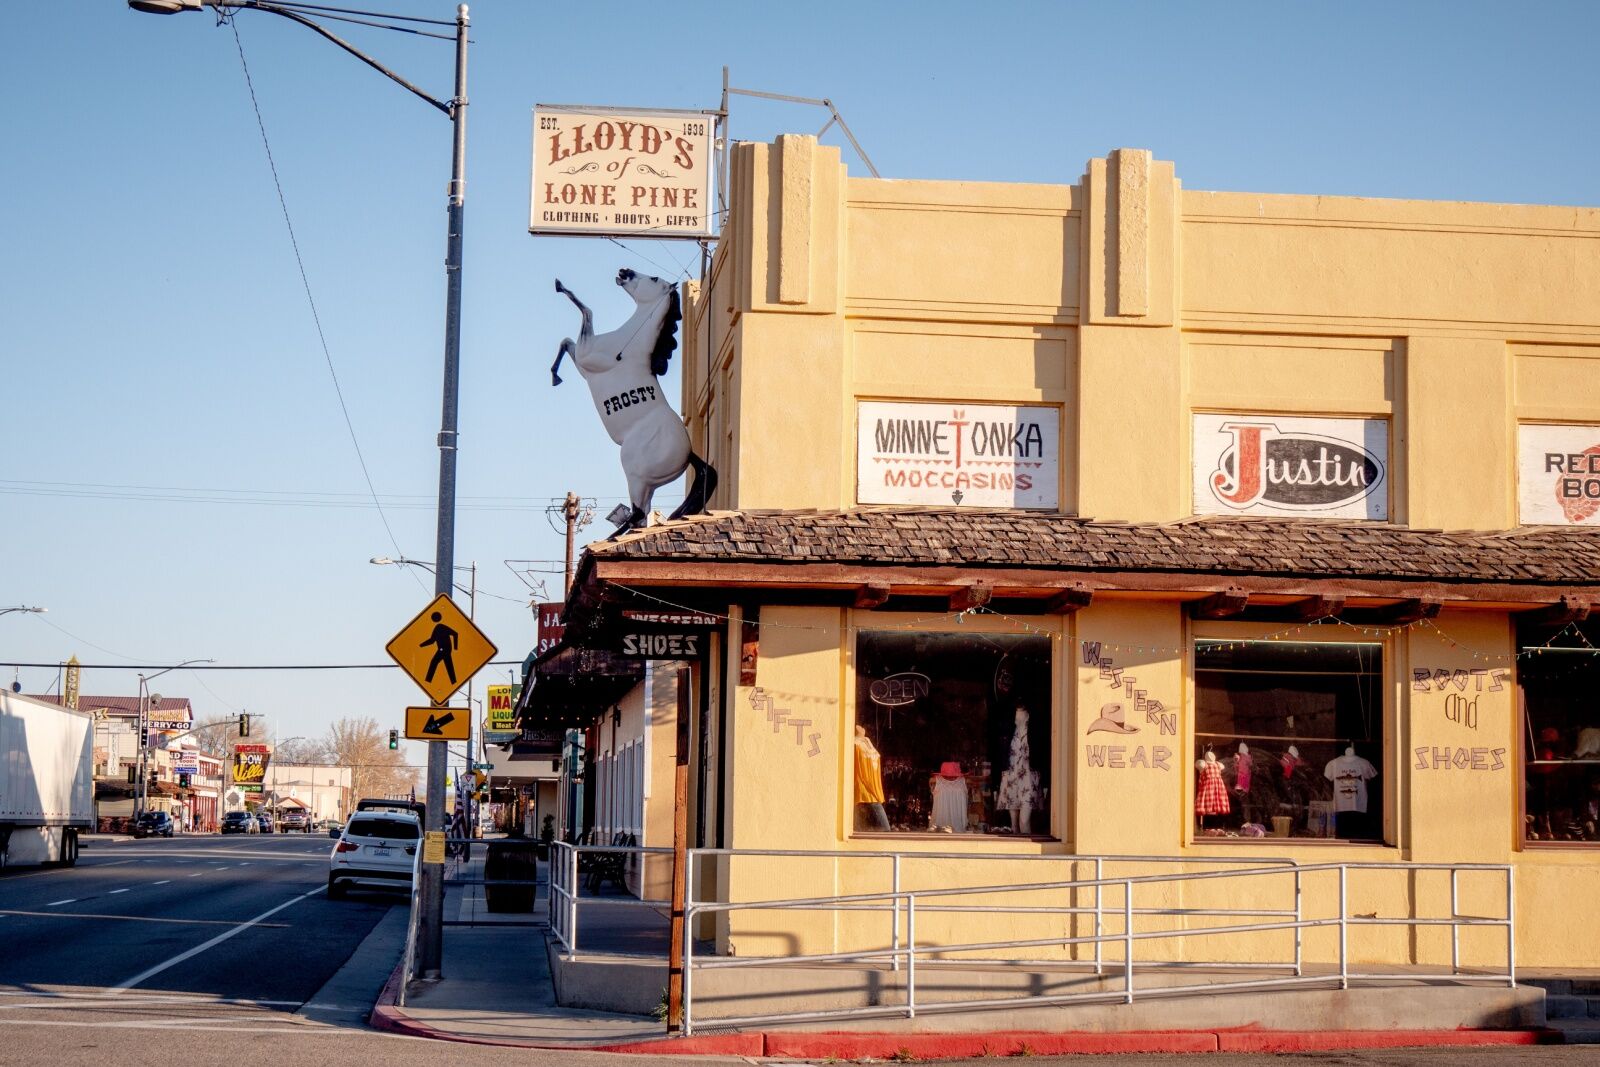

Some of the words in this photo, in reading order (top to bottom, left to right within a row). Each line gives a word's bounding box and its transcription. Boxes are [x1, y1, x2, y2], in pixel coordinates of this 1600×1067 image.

[540, 117, 560, 131] EST.
[683, 123, 704, 136] 1938
[548, 121, 694, 170] LLOYD'S
[606, 157, 636, 180] of
[544, 182, 616, 206] LONE
[631, 185, 698, 209] PINE
[543, 211, 599, 223] CLOTHING
[615, 213, 651, 225] BOOTS
[666, 215, 698, 227] GIFTS
[603, 385, 656, 416] FROSTY
[875, 418, 1043, 469] MINNETONKA
[1212, 425, 1371, 504] Justin
[884, 469, 1033, 491] MOCCASINS
[623, 634, 698, 656] SHOES
[870, 679, 929, 699] OPEN
[1082, 641, 1177, 736] WESTERN
[1413, 667, 1506, 692] BOOTS
[749, 686, 821, 758] GIFTS
[1445, 693, 1480, 731] and
[234, 744, 270, 753] MOTEL
[1086, 744, 1172, 772] WEAR
[1414, 746, 1506, 771] SHOES
[233, 764, 264, 782] Villa
